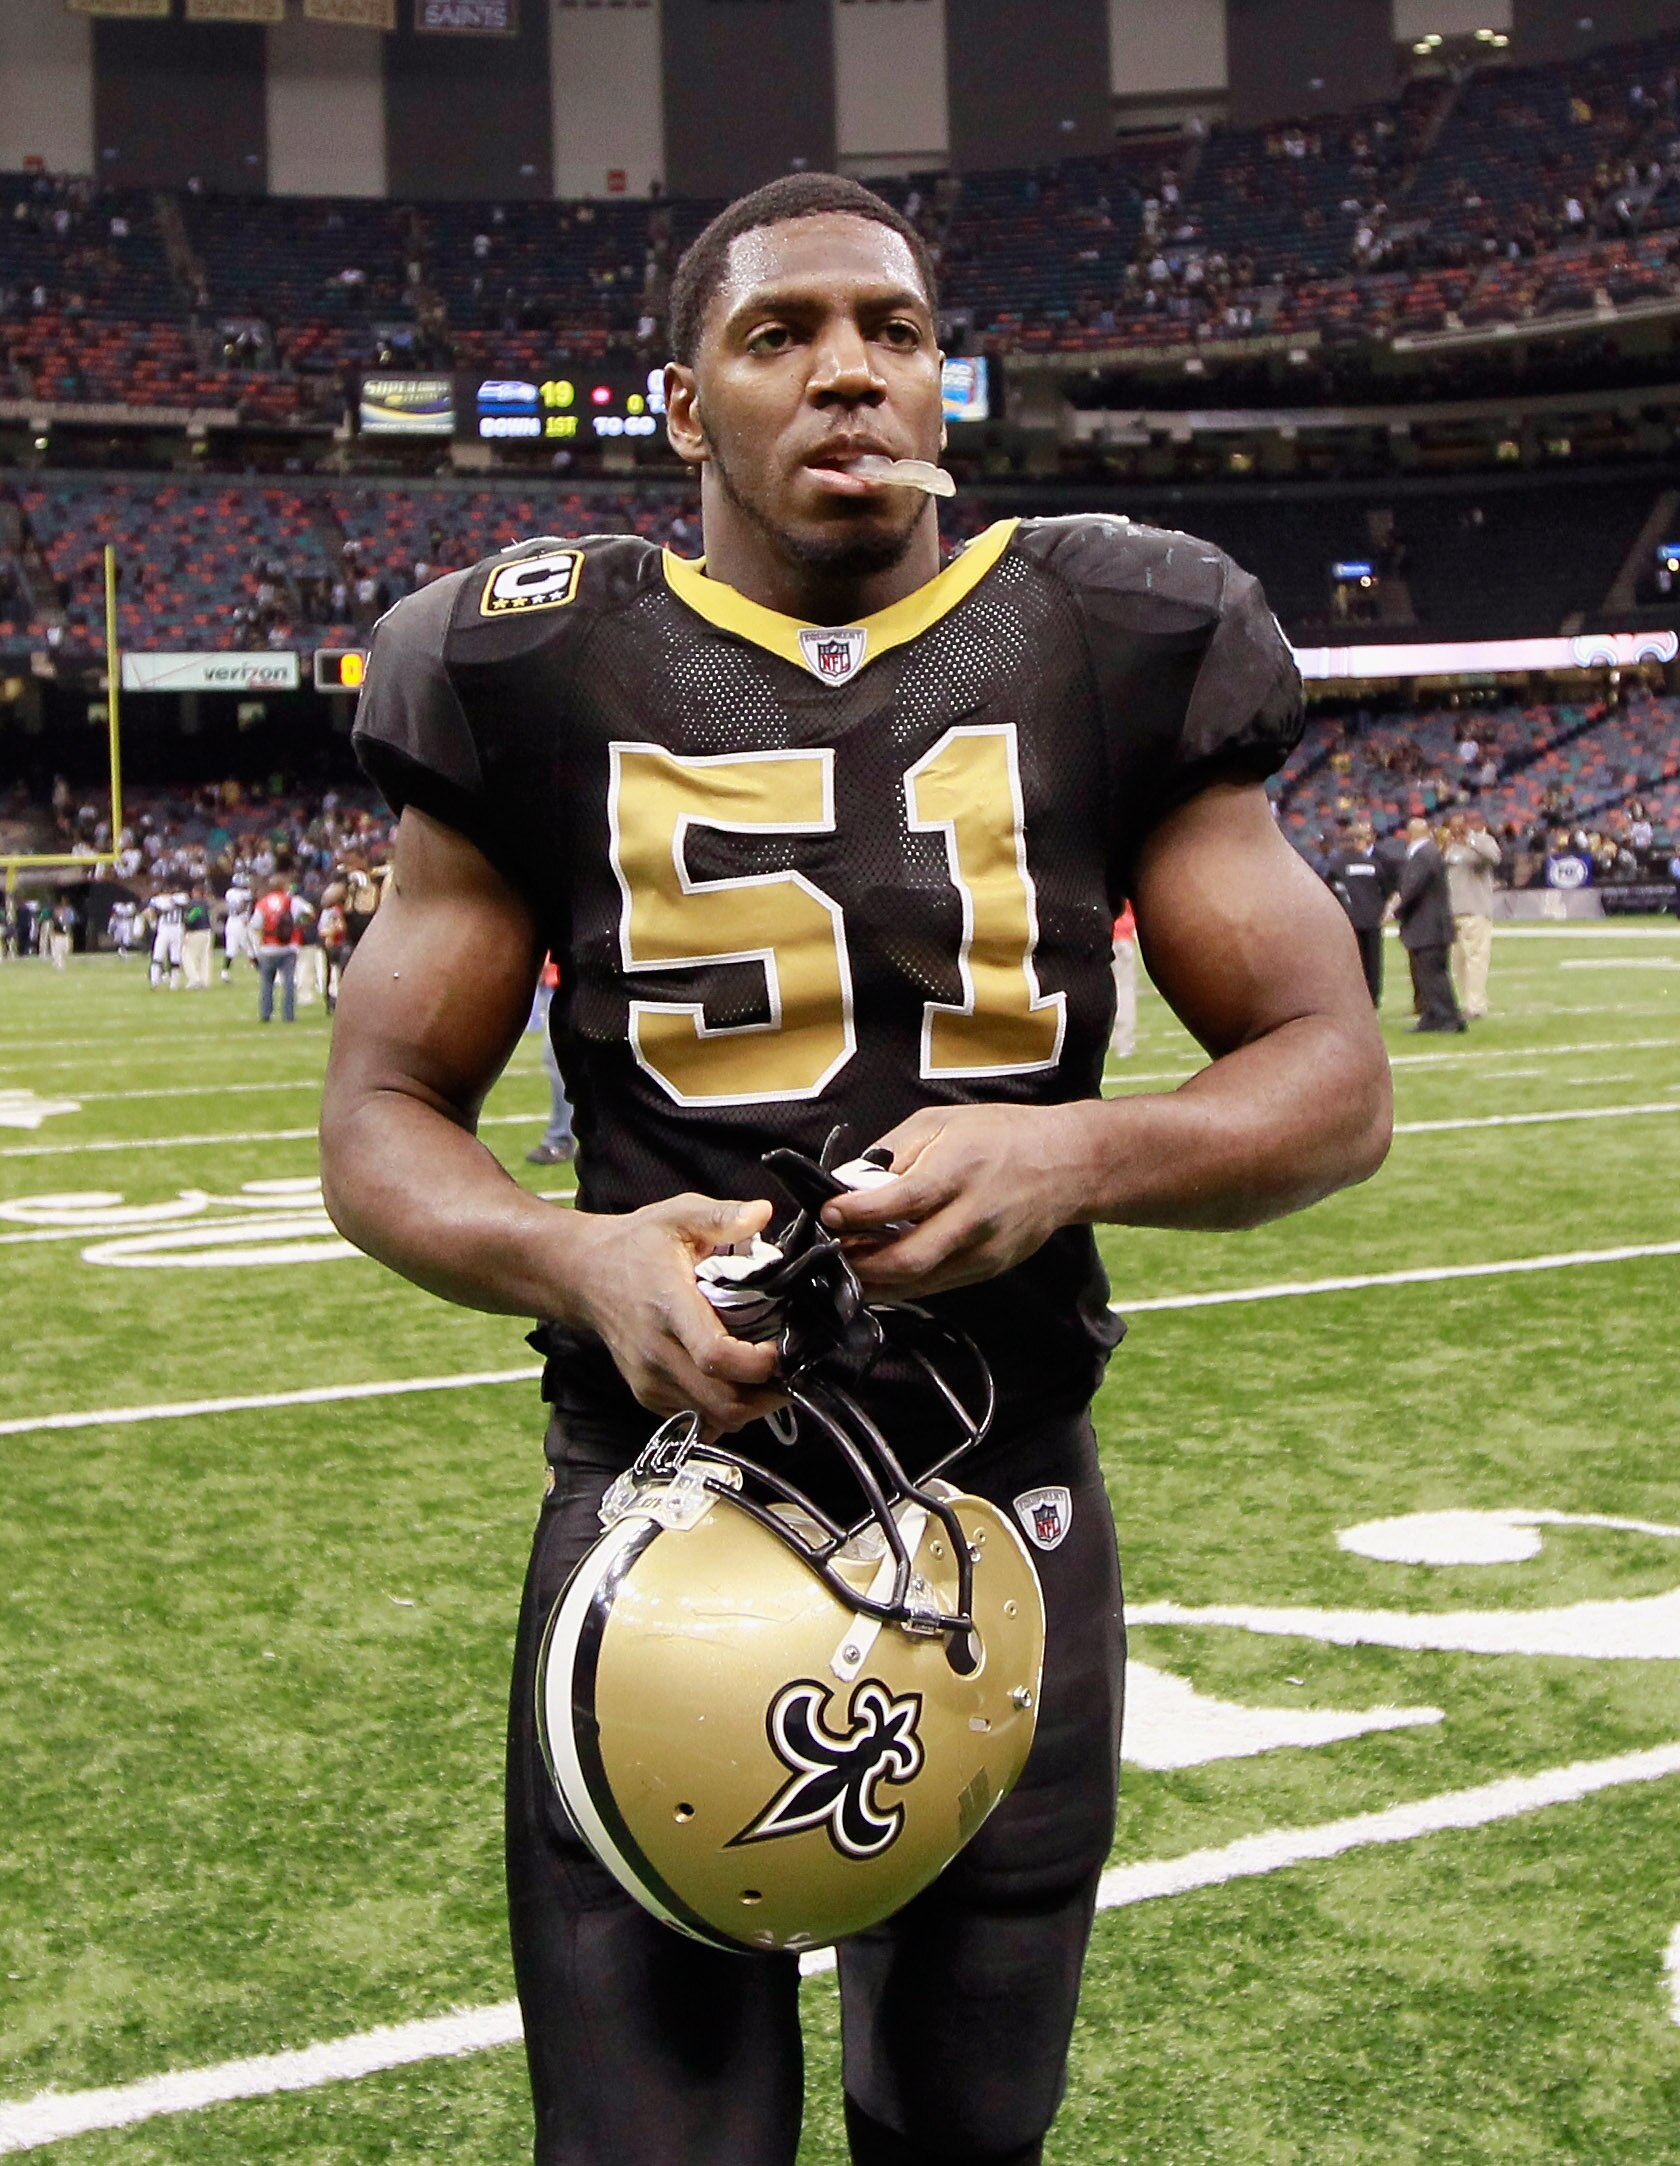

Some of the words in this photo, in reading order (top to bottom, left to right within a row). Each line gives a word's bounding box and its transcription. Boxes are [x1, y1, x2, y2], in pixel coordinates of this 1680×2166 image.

[424, 4, 507, 27] SAINTS
[539, 380, 575, 408] 19
[479, 417, 542, 438] DOWN
[545, 416, 579, 437] 1ST
[592, 416, 623, 437] TO
[493, 555, 573, 600] C
[204, 660, 288, 684] verizon
[820, 653, 849, 673] NFL
[607, 722, 1067, 1107] 51
[1037, 1518, 1060, 1538] NFL
